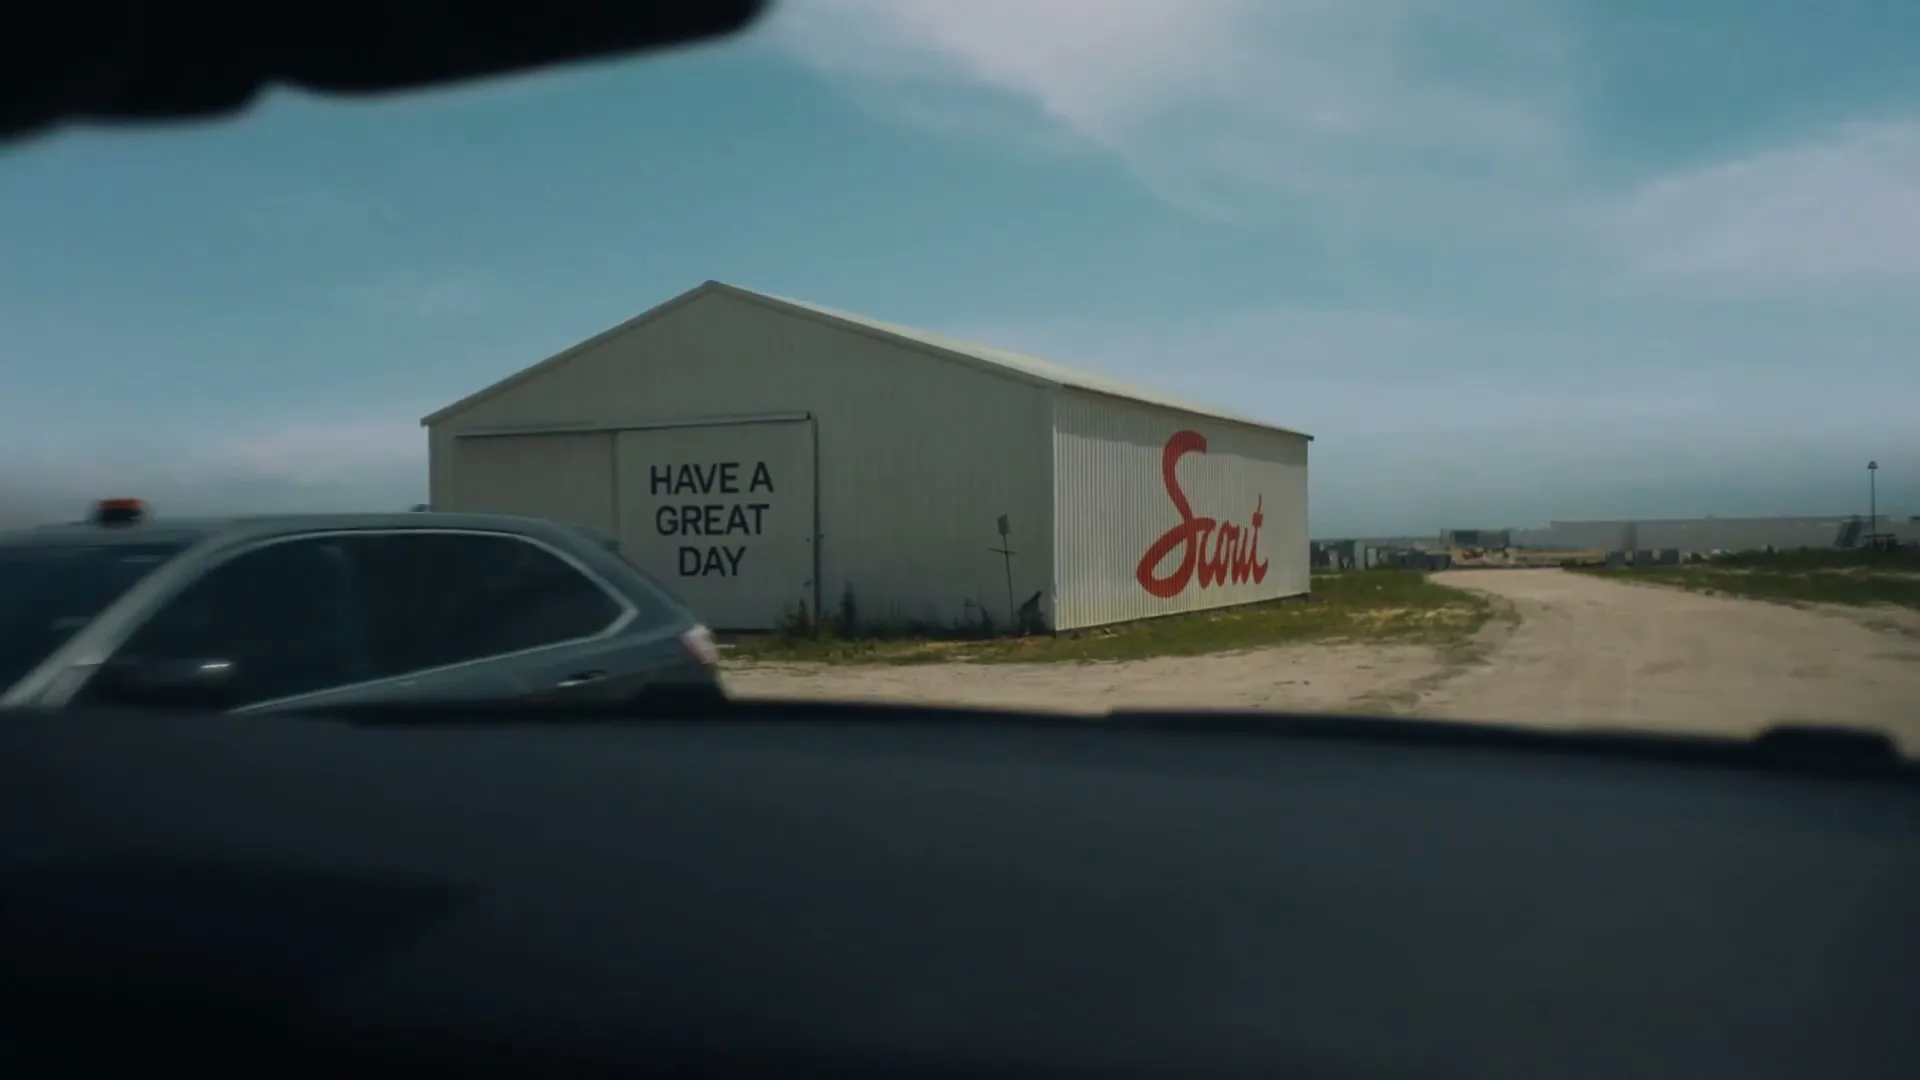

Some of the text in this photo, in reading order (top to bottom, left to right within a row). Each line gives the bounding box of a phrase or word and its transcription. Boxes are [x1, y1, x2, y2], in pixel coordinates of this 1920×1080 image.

[650, 461, 774, 495] HAVE A
[655, 503, 770, 536] GREAT
[1137, 430, 1269, 598] Scout
[679, 546, 747, 577] DAY
